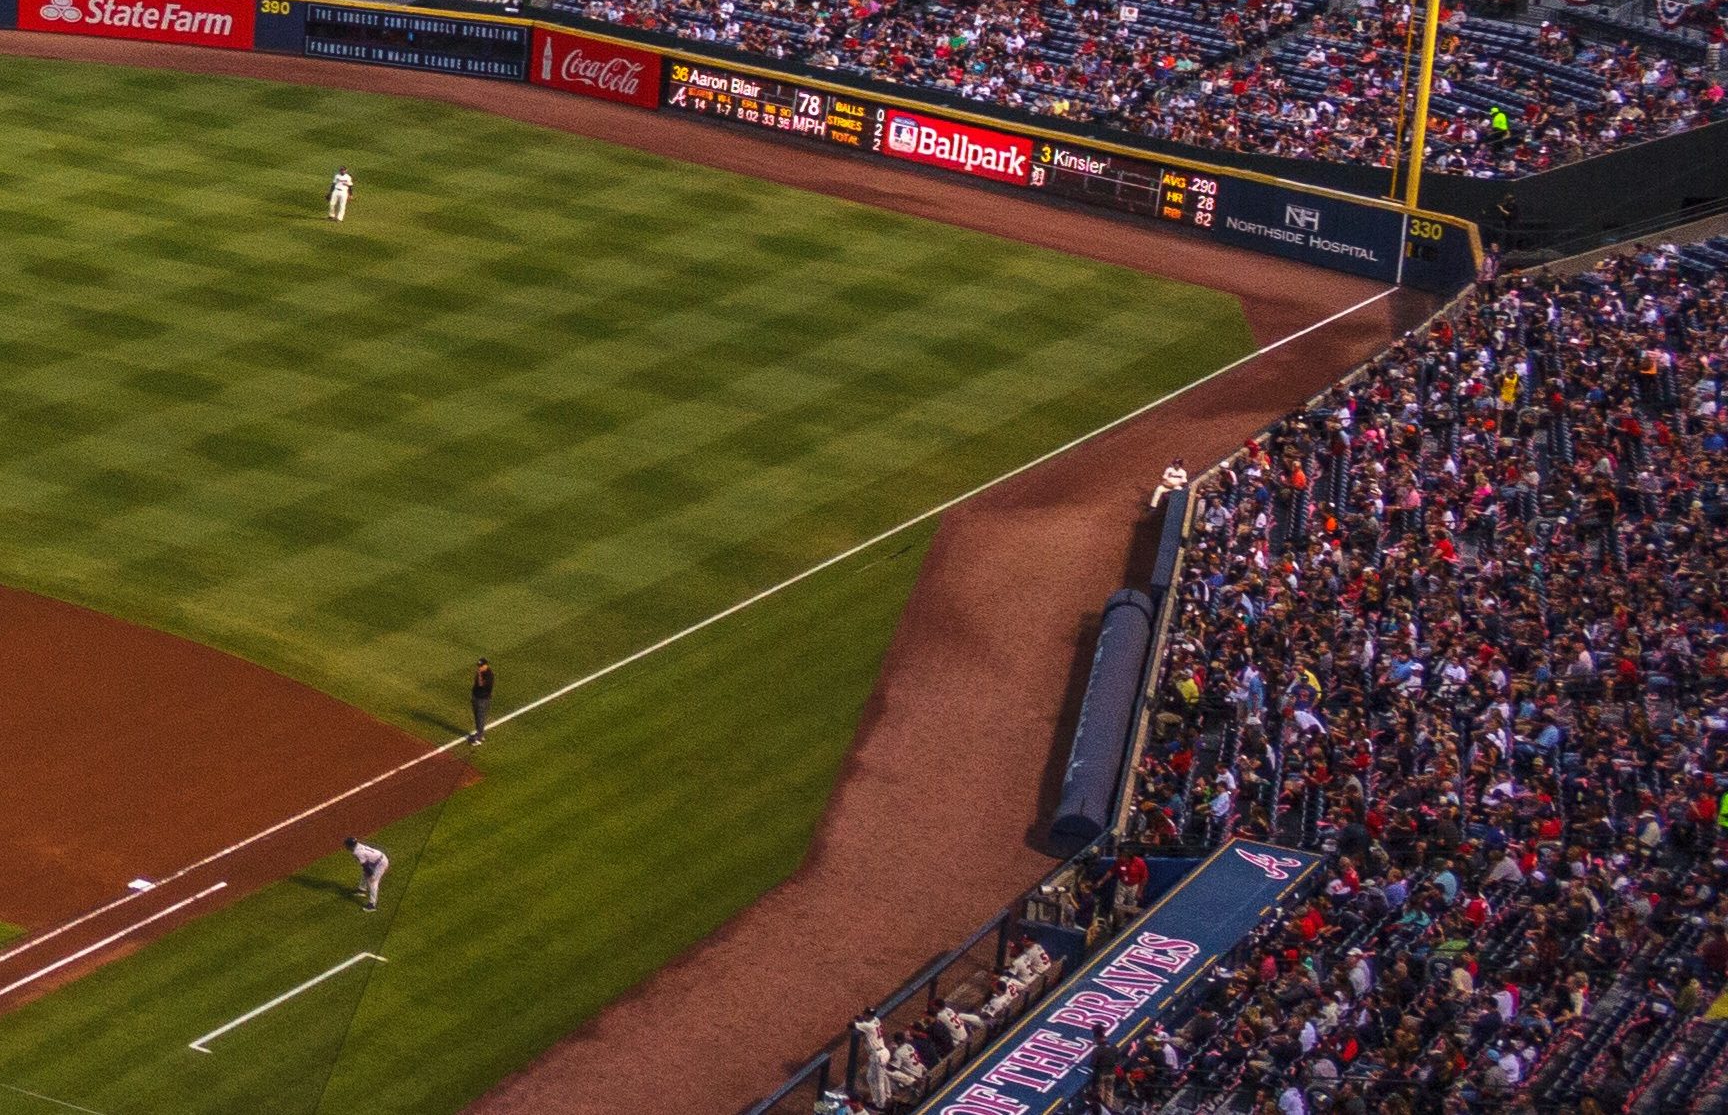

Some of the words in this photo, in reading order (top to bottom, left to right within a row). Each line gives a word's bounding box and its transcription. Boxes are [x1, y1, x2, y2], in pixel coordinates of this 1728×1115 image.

[261, 0, 290, 15] 390
[561, 49, 644, 95] Coca-Cola
[689, 71, 727, 91] Aaron
[731, 78, 761, 97] Blair
[799, 93, 821, 116] 78
[917, 125, 1027, 177] Ballpark
[1041, 147, 1051, 163] 3
[1054, 149, 1105, 175] Kinsler
[1163, 174, 1186, 188] AVG
[1188, 178, 1216, 195] .290
[1226, 216, 1304, 245] NORTHSIDE
[1309, 236, 1379, 262] HOSPITAL
[1410, 220, 1442, 240] 330
[980, 1028, 1093, 1093] THE
[1048, 931, 1200, 1038] BRAVES
